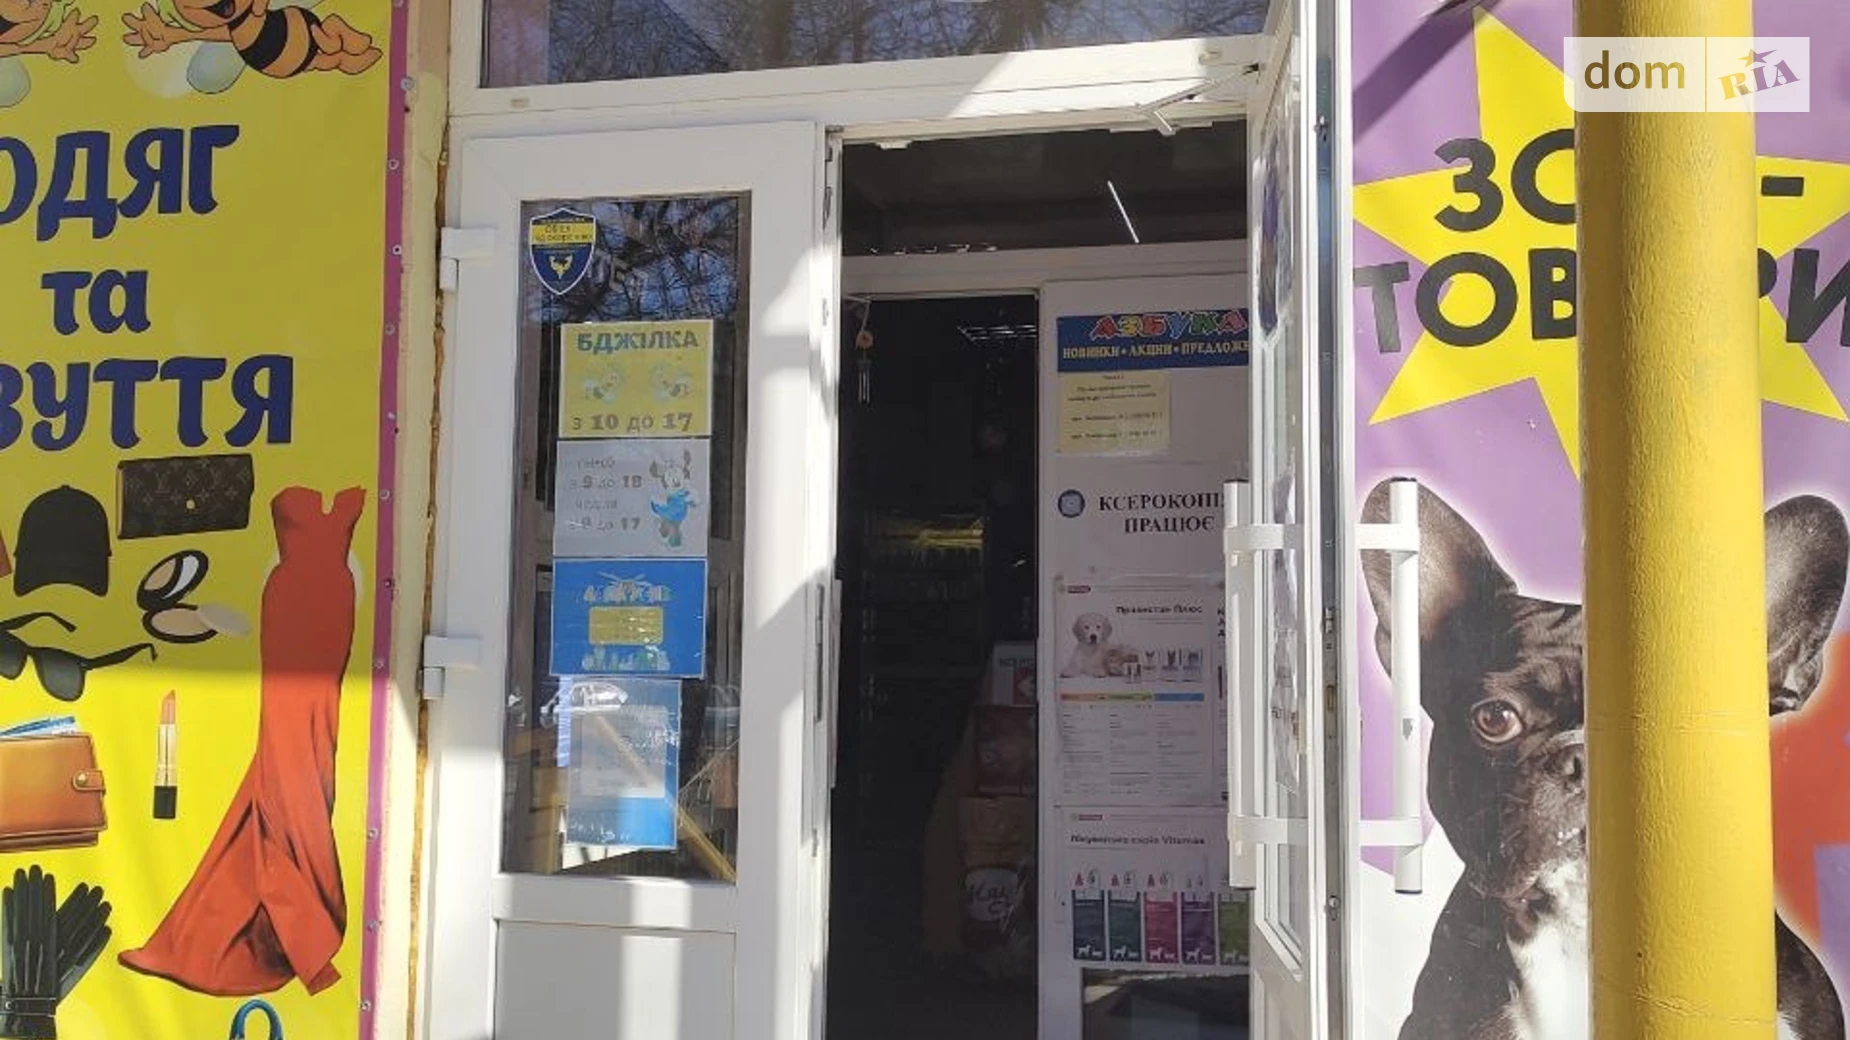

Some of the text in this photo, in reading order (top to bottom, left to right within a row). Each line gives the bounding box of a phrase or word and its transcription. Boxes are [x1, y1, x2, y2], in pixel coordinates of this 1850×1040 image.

[1434, 128, 1805, 232] ЗО-
[41, 269, 151, 335] та
[1354, 247, 1850, 354] ТОВИ
[1089, 308, 1248, 341] АЗБУКА
[577, 330, 699, 355] БДЖІЛКА
[1063, 346, 1118, 359] НОВИНКИ
[591, 413, 619, 431] 10
[627, 414, 654, 434] до
[662, 411, 692, 432] 17
[622, 474, 642, 488] 18
[1100, 493, 1224, 511] КСЕРОКОПІ
[620, 516, 641, 531] 17
[1124, 515, 1214, 533] ПРАЦЮЄ
